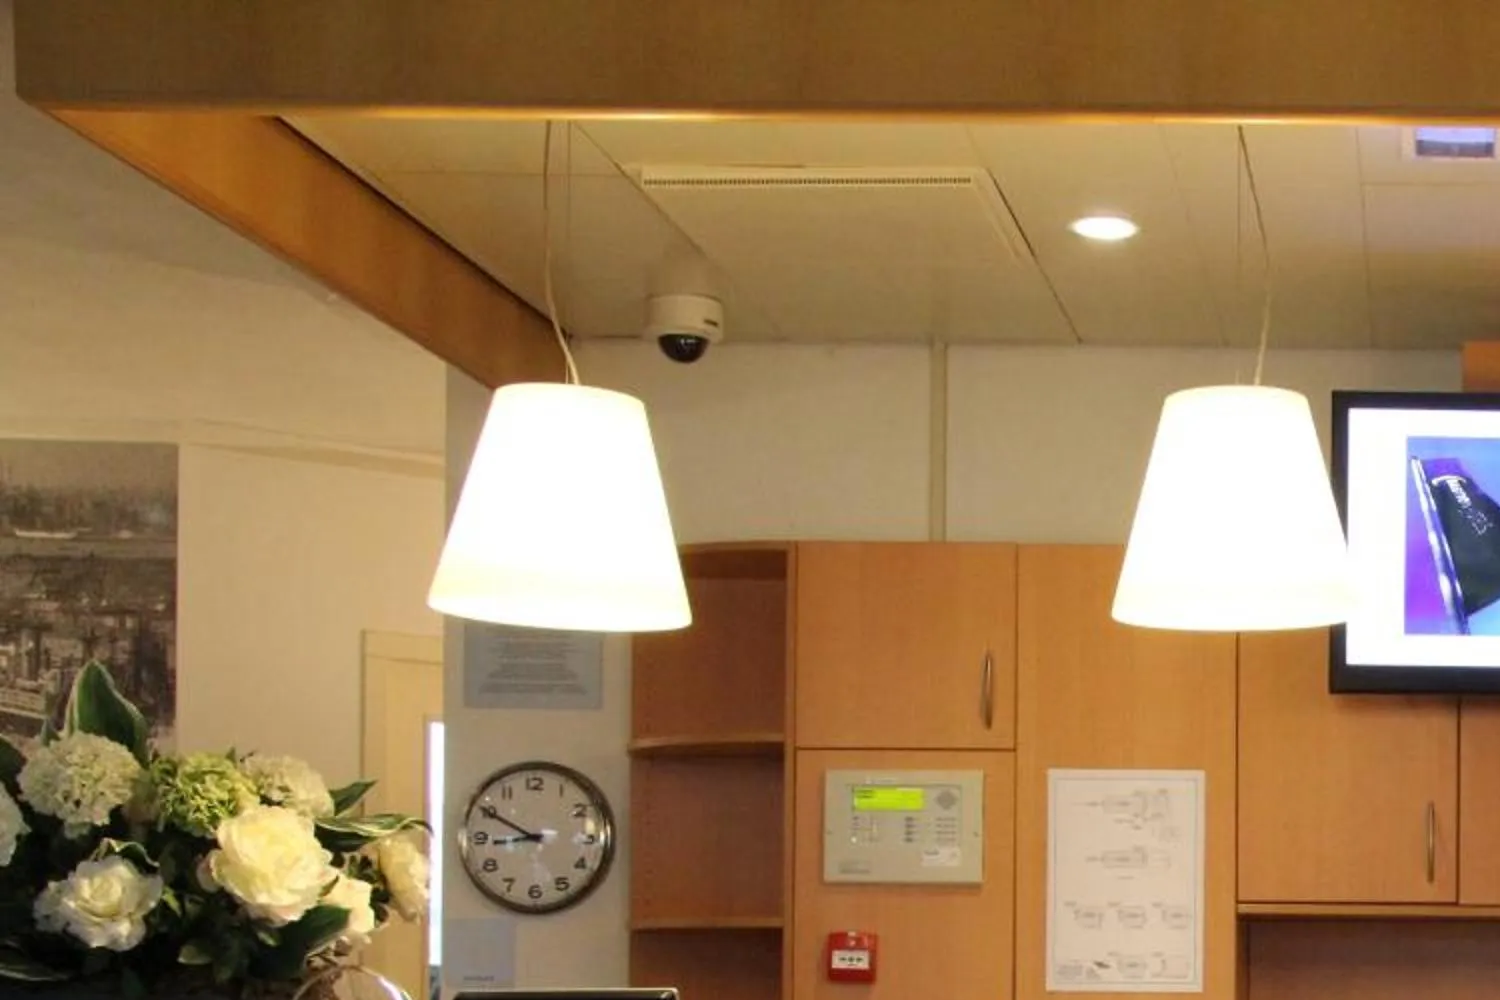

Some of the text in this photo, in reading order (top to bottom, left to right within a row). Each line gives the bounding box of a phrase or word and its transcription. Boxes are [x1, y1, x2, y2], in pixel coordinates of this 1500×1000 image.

[526, 777, 544, 791] 12
[502, 786, 513, 799] 11
[572, 803, 587, 818] 2
[474, 831, 488, 845] 9
[482, 858, 499, 872] 8
[574, 856, 587, 870] 4
[502, 877, 515, 893] 7
[554, 877, 570, 891] 5
[527, 884, 543, 899] 6
